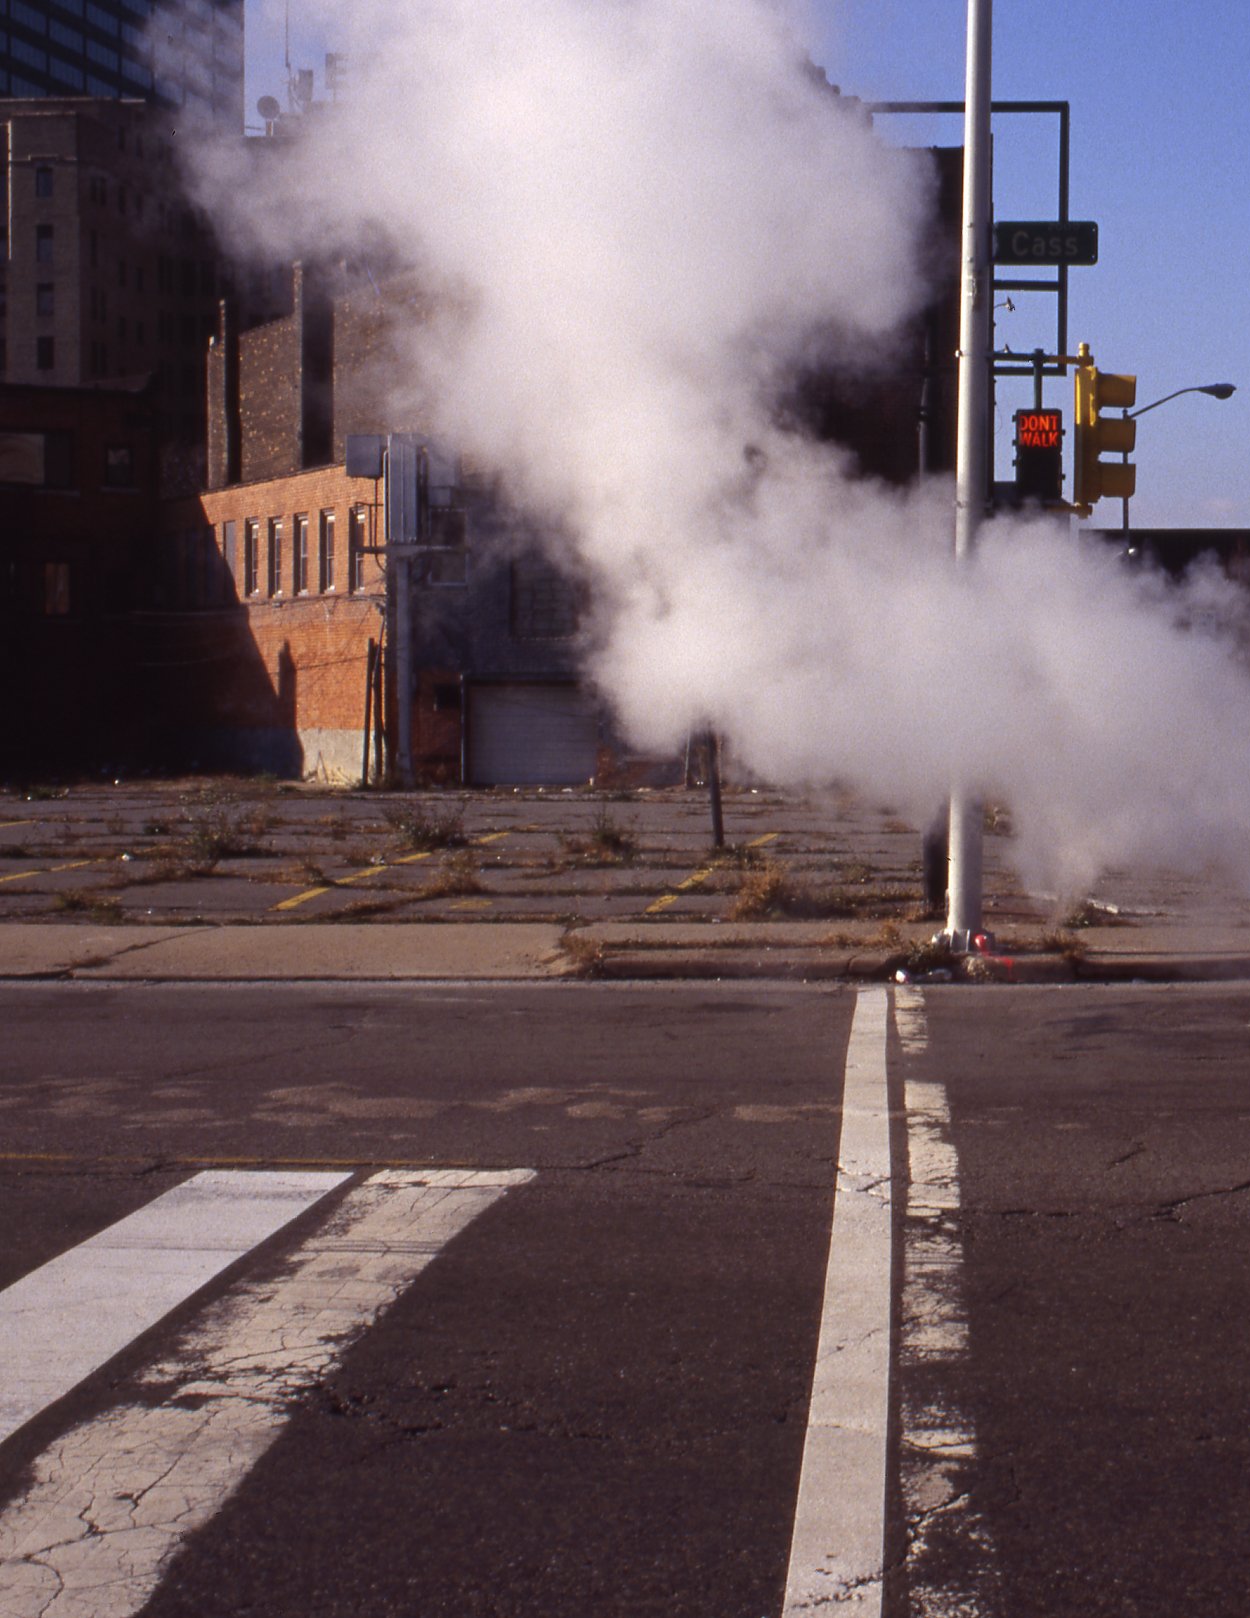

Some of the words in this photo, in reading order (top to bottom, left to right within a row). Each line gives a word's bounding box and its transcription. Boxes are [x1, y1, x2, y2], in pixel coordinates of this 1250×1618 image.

[1011, 229, 1079, 257] Cass
[1019, 415, 1058, 431] DONT
[1019, 431, 1058, 448] WALK
